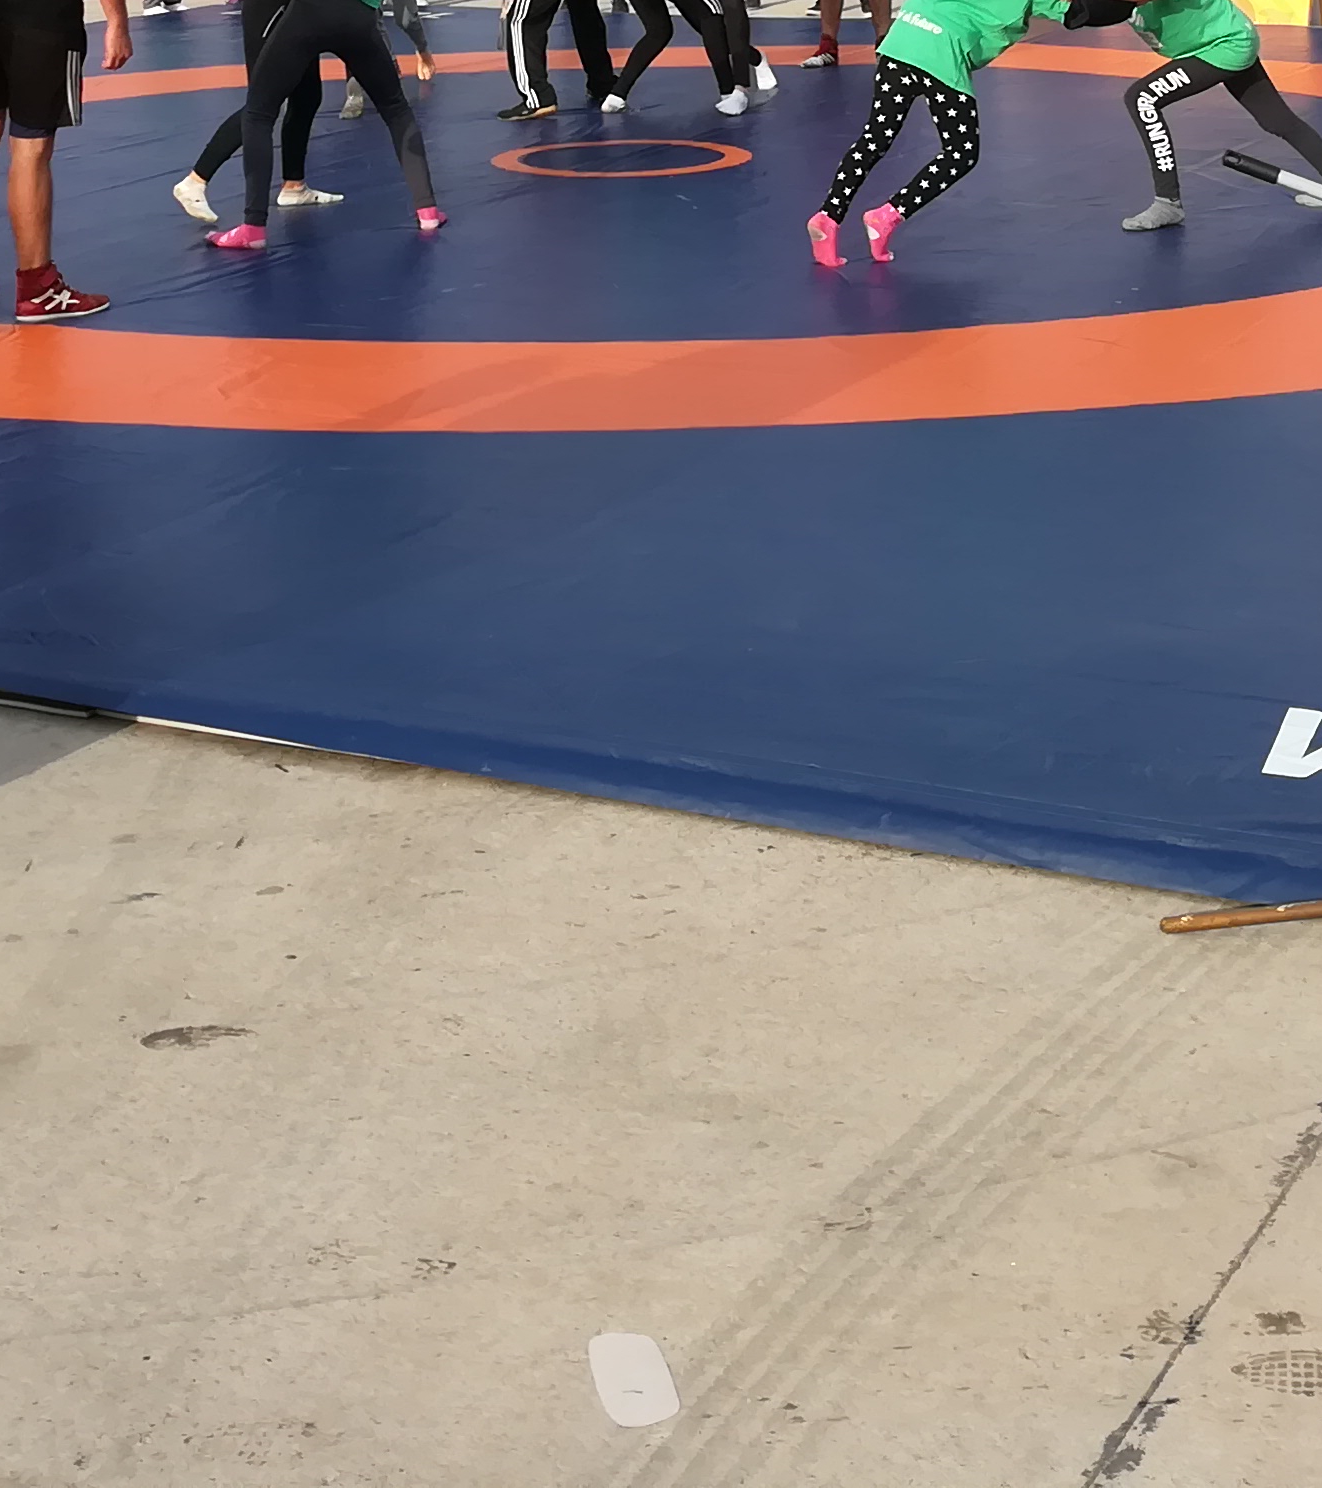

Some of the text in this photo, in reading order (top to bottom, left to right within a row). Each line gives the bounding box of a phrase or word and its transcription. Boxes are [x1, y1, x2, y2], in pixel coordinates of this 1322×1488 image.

[1137, 67, 1191, 172] #RUN GIRL RUN
